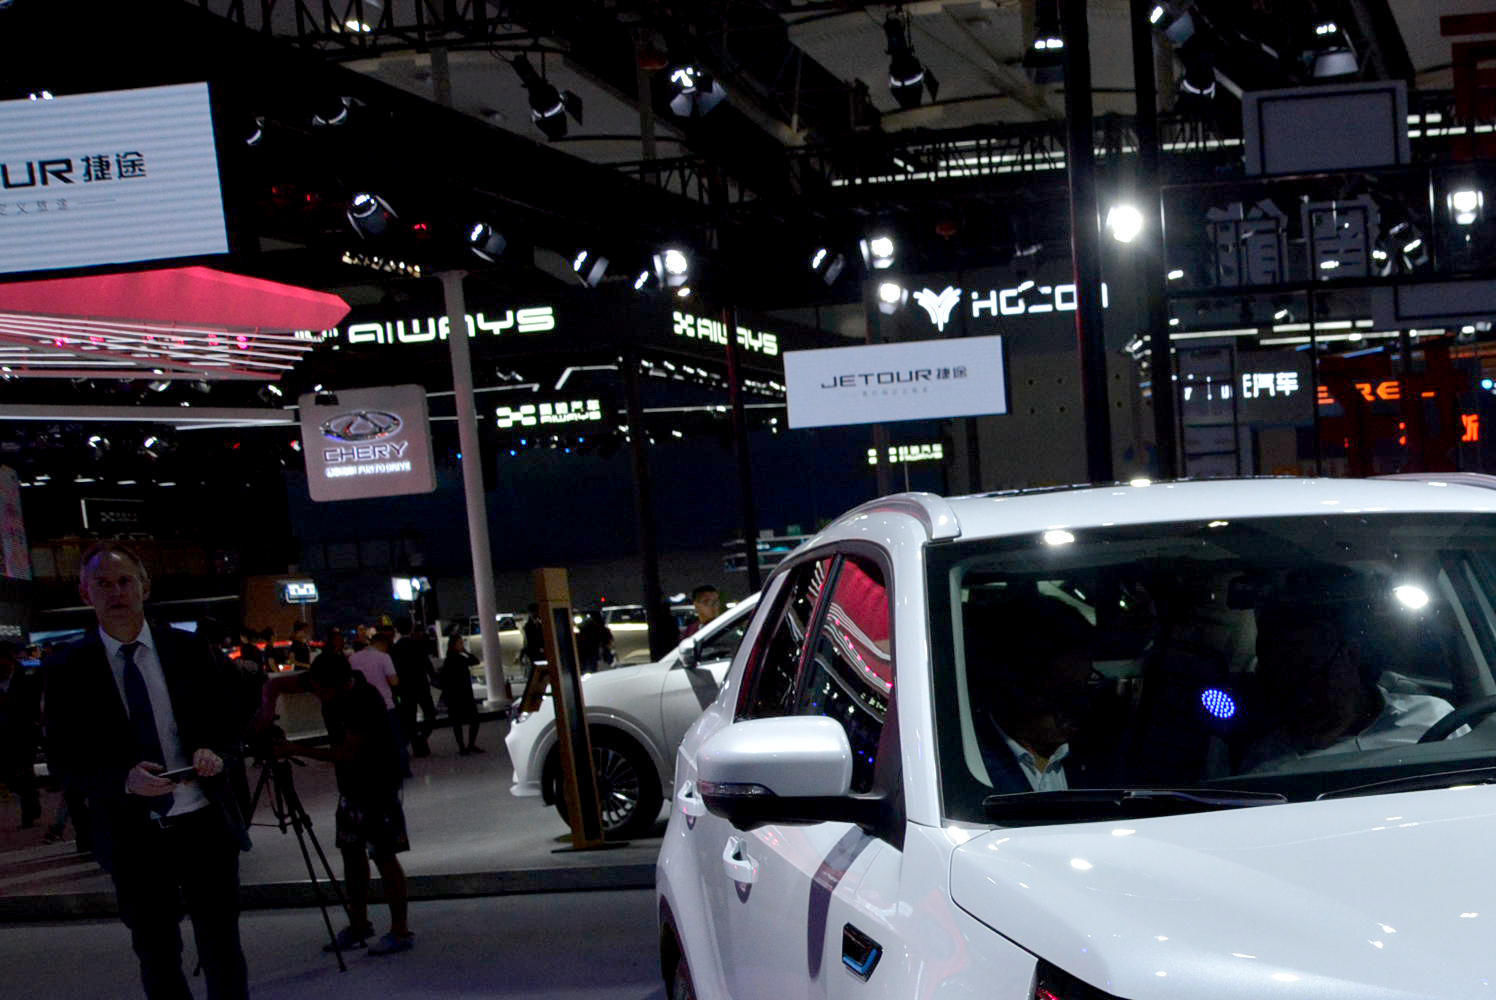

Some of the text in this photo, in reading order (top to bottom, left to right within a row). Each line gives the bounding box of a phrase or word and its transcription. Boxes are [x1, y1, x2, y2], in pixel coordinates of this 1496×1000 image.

[80, 151, 147, 183] 捷途
[820, 368, 932, 389] JETOUR
[323, 440, 409, 464] CHERY
